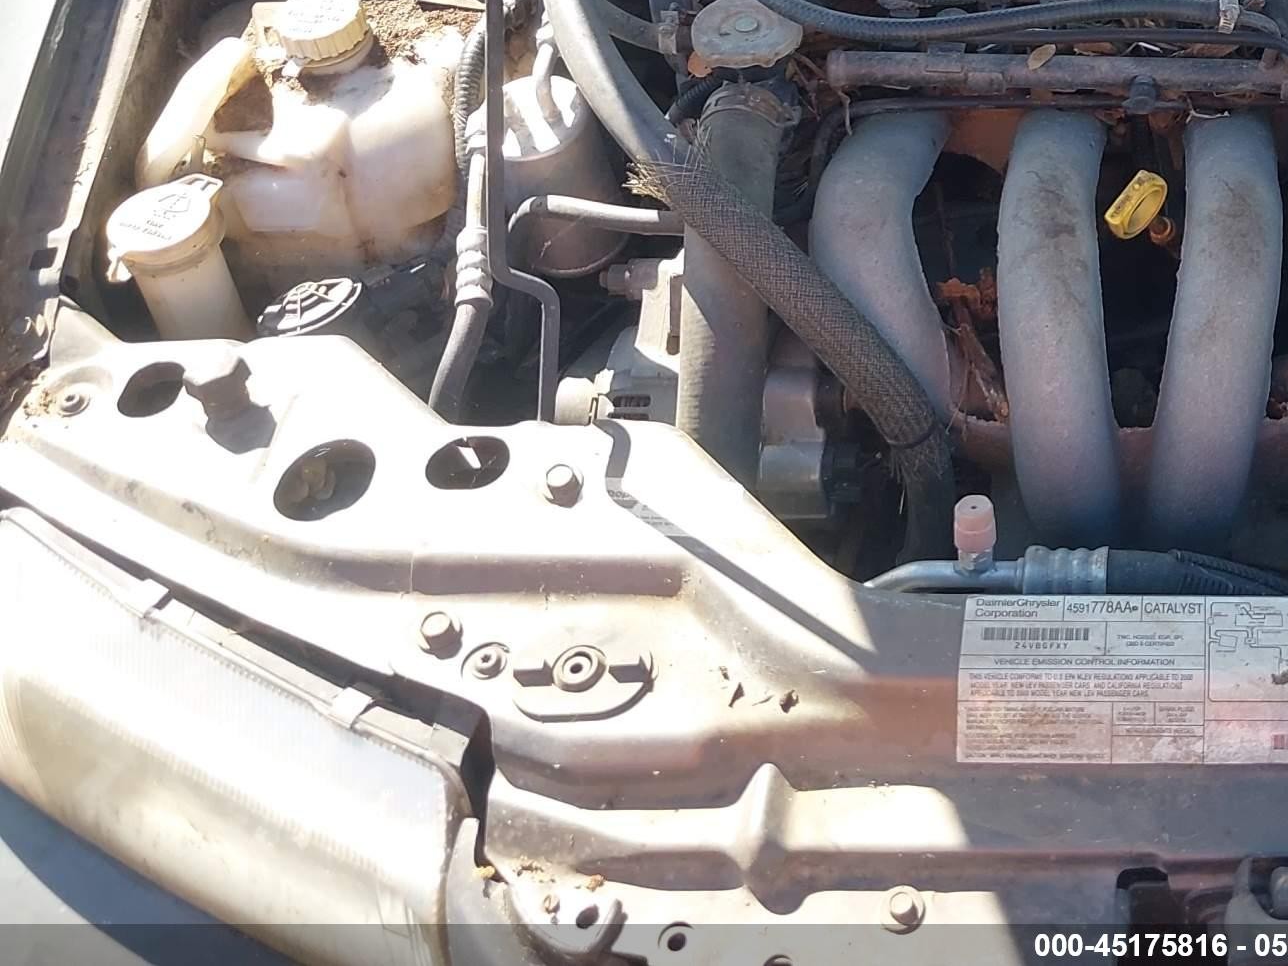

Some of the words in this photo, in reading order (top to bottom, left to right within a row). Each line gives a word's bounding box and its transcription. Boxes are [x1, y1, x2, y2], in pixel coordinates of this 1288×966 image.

[976, 598, 1061, 608] DaimlerChrysler
[1144, 602, 1204, 614] CATALYST
[975, 608, 1038, 619] Corporation
[993, 658, 1029, 666] VEHICLE
[1032, 658, 1072, 666] EMISSION
[1075, 658, 1115, 666] CONTROL
[1117, 658, 1175, 666] INFORMATION
